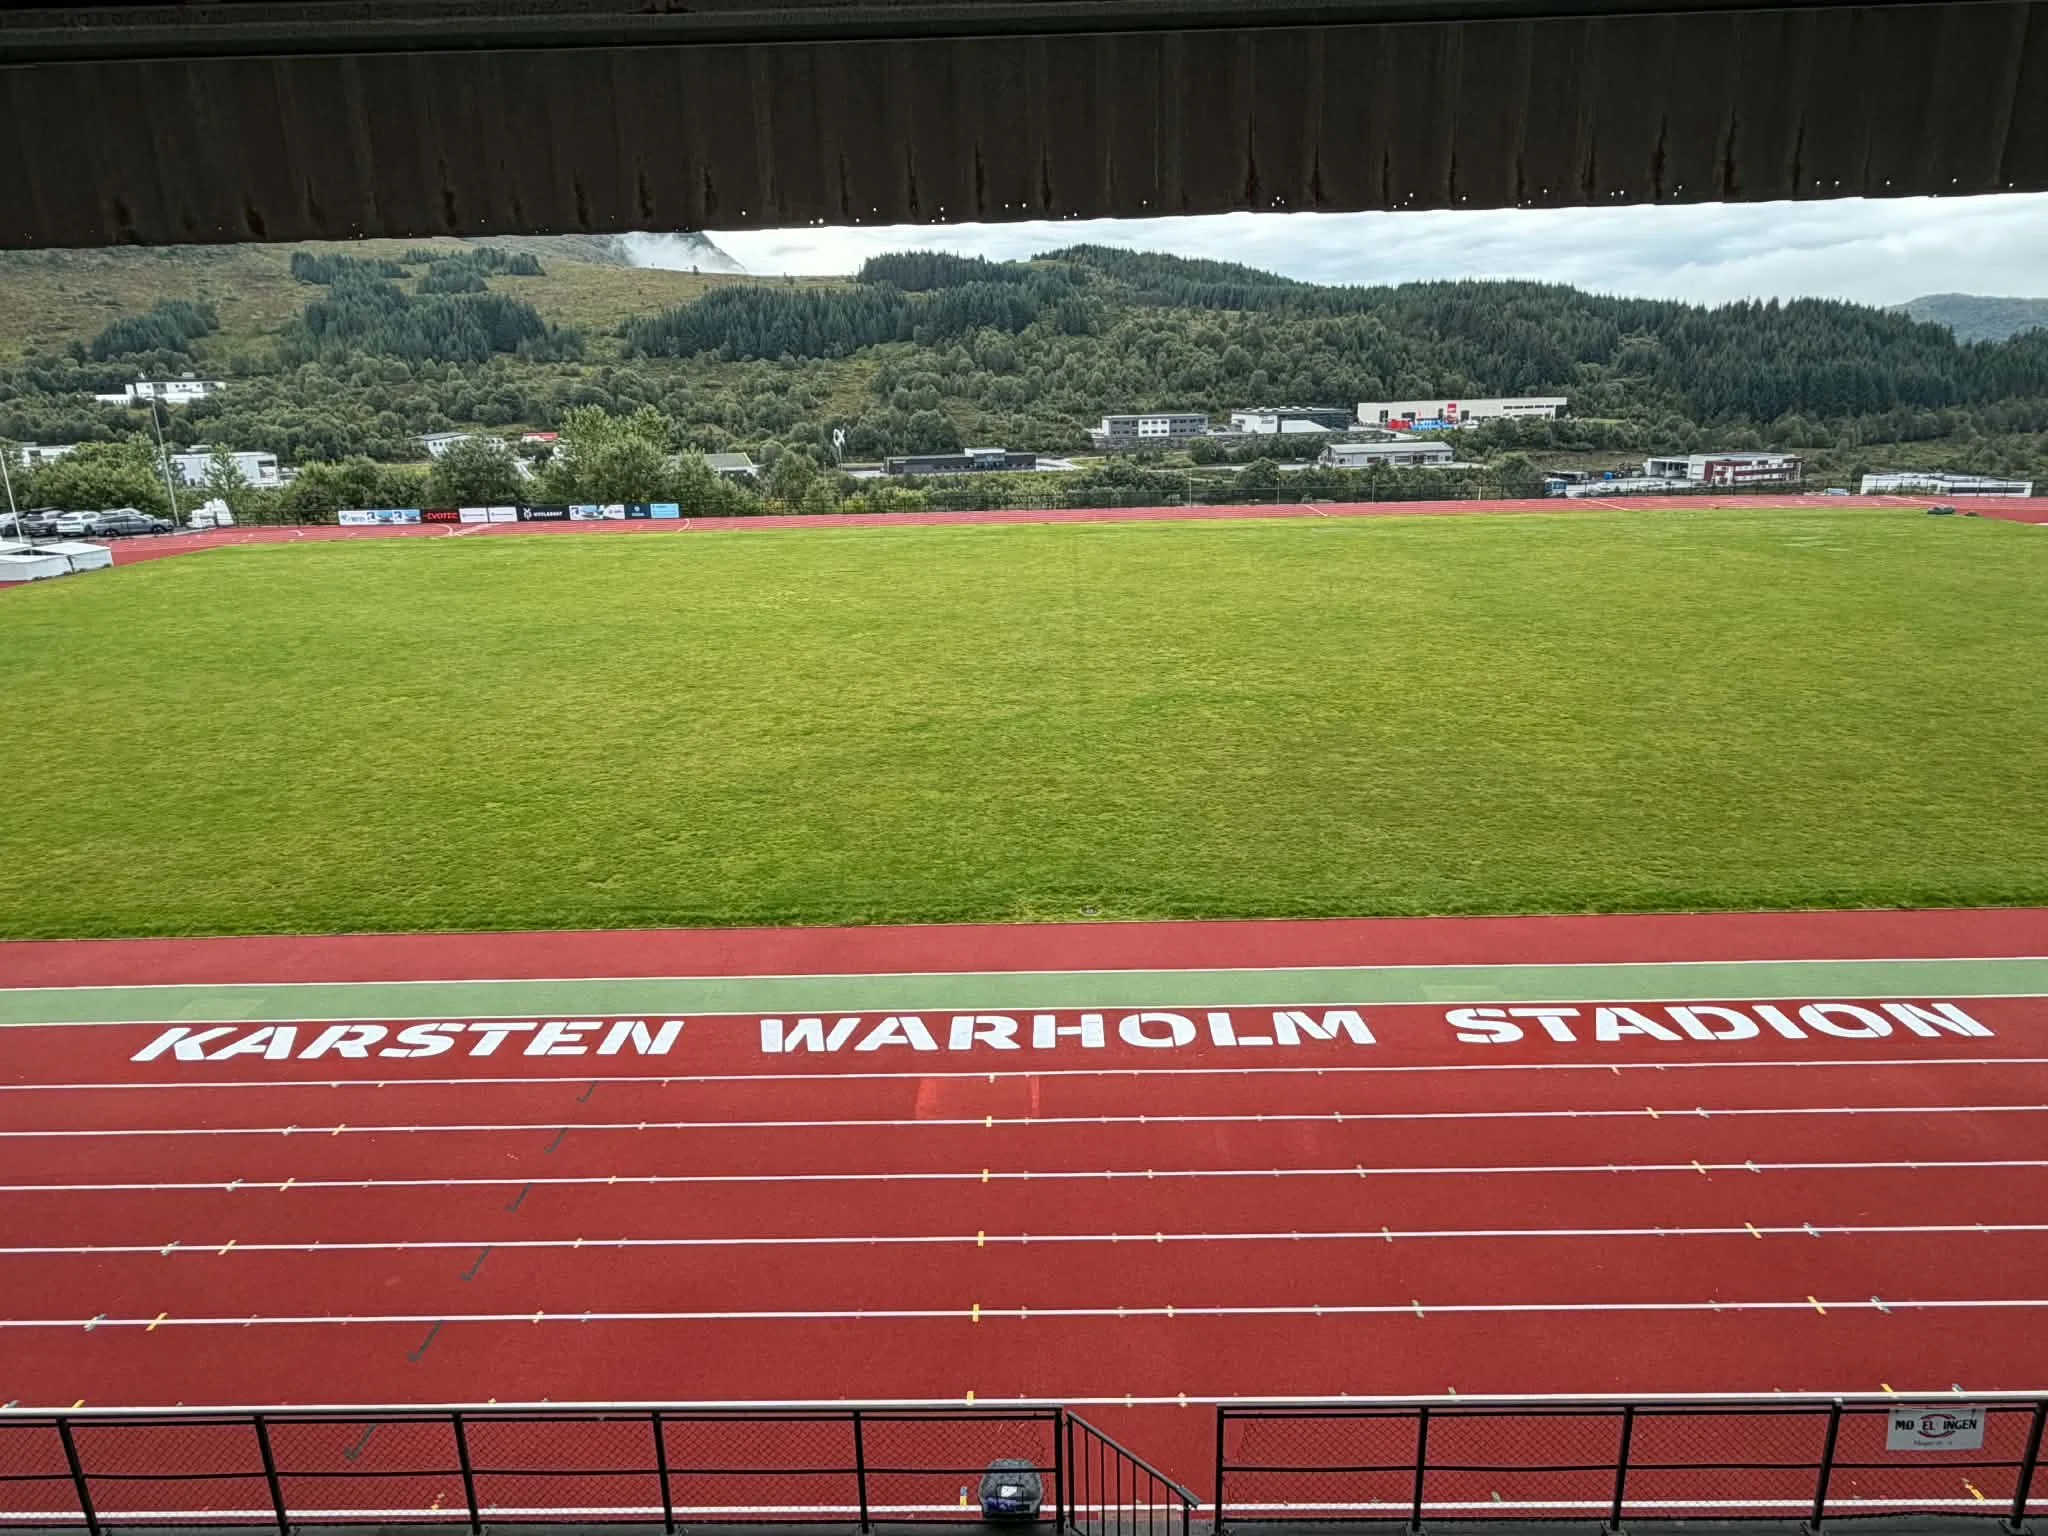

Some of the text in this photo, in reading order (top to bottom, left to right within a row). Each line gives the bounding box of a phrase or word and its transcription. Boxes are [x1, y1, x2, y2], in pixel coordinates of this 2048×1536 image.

[131, 1002, 1994, 1061] KARSTEN WARHOLM STADION
